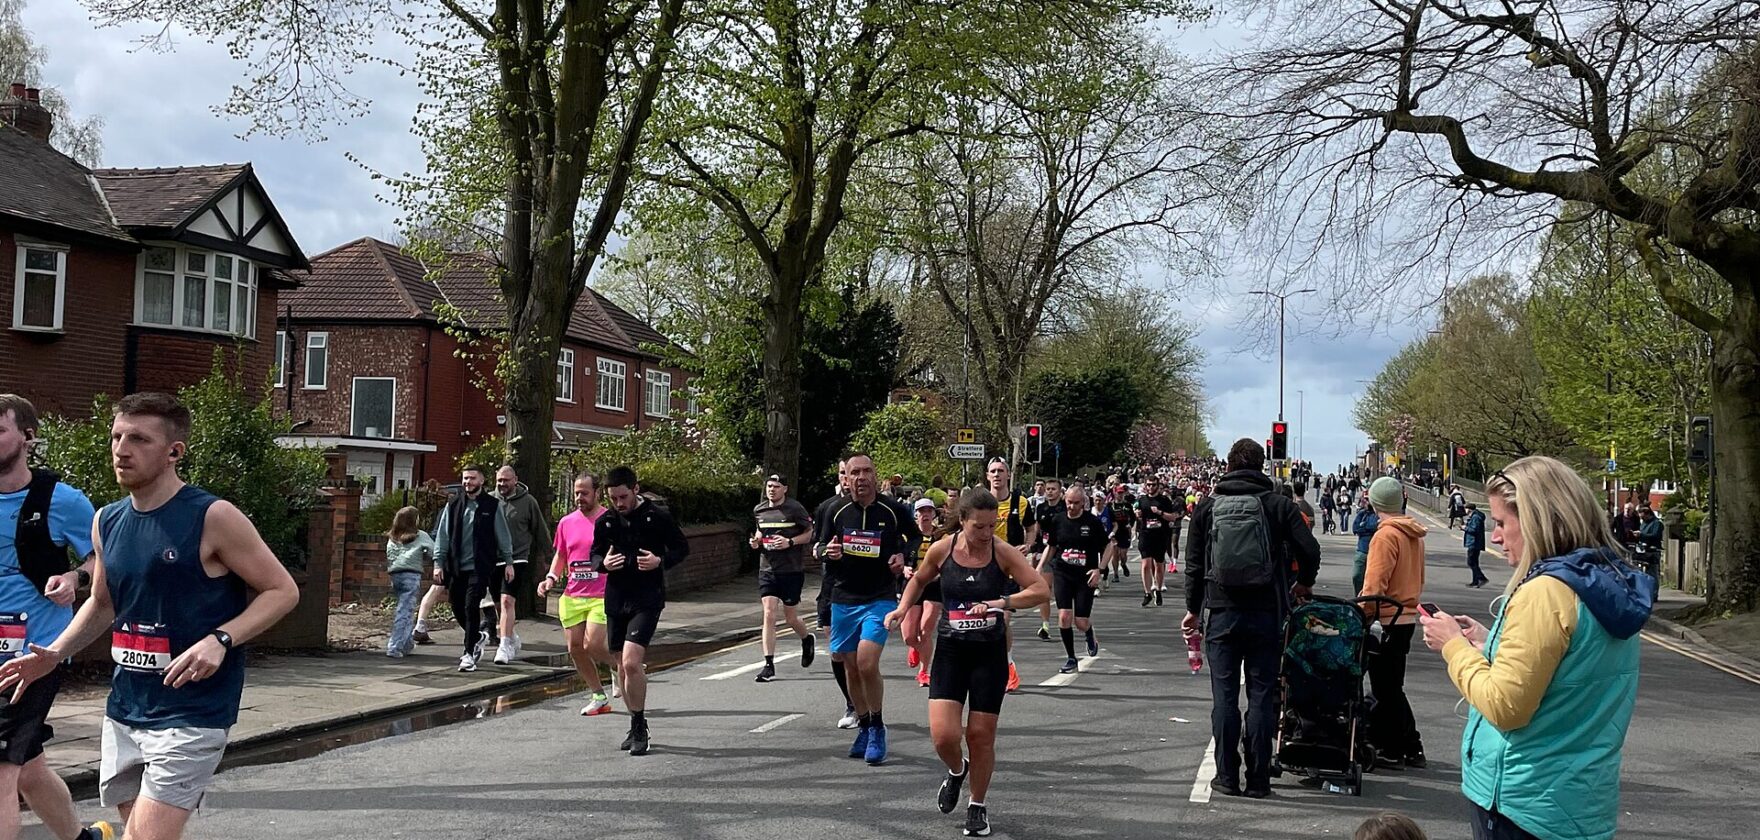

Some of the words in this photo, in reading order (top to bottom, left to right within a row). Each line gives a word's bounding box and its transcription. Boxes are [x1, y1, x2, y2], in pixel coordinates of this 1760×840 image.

[958, 620, 988, 629] 23202
[0, 639, 9, 650] 6
[122, 651, 157, 667] 28074
